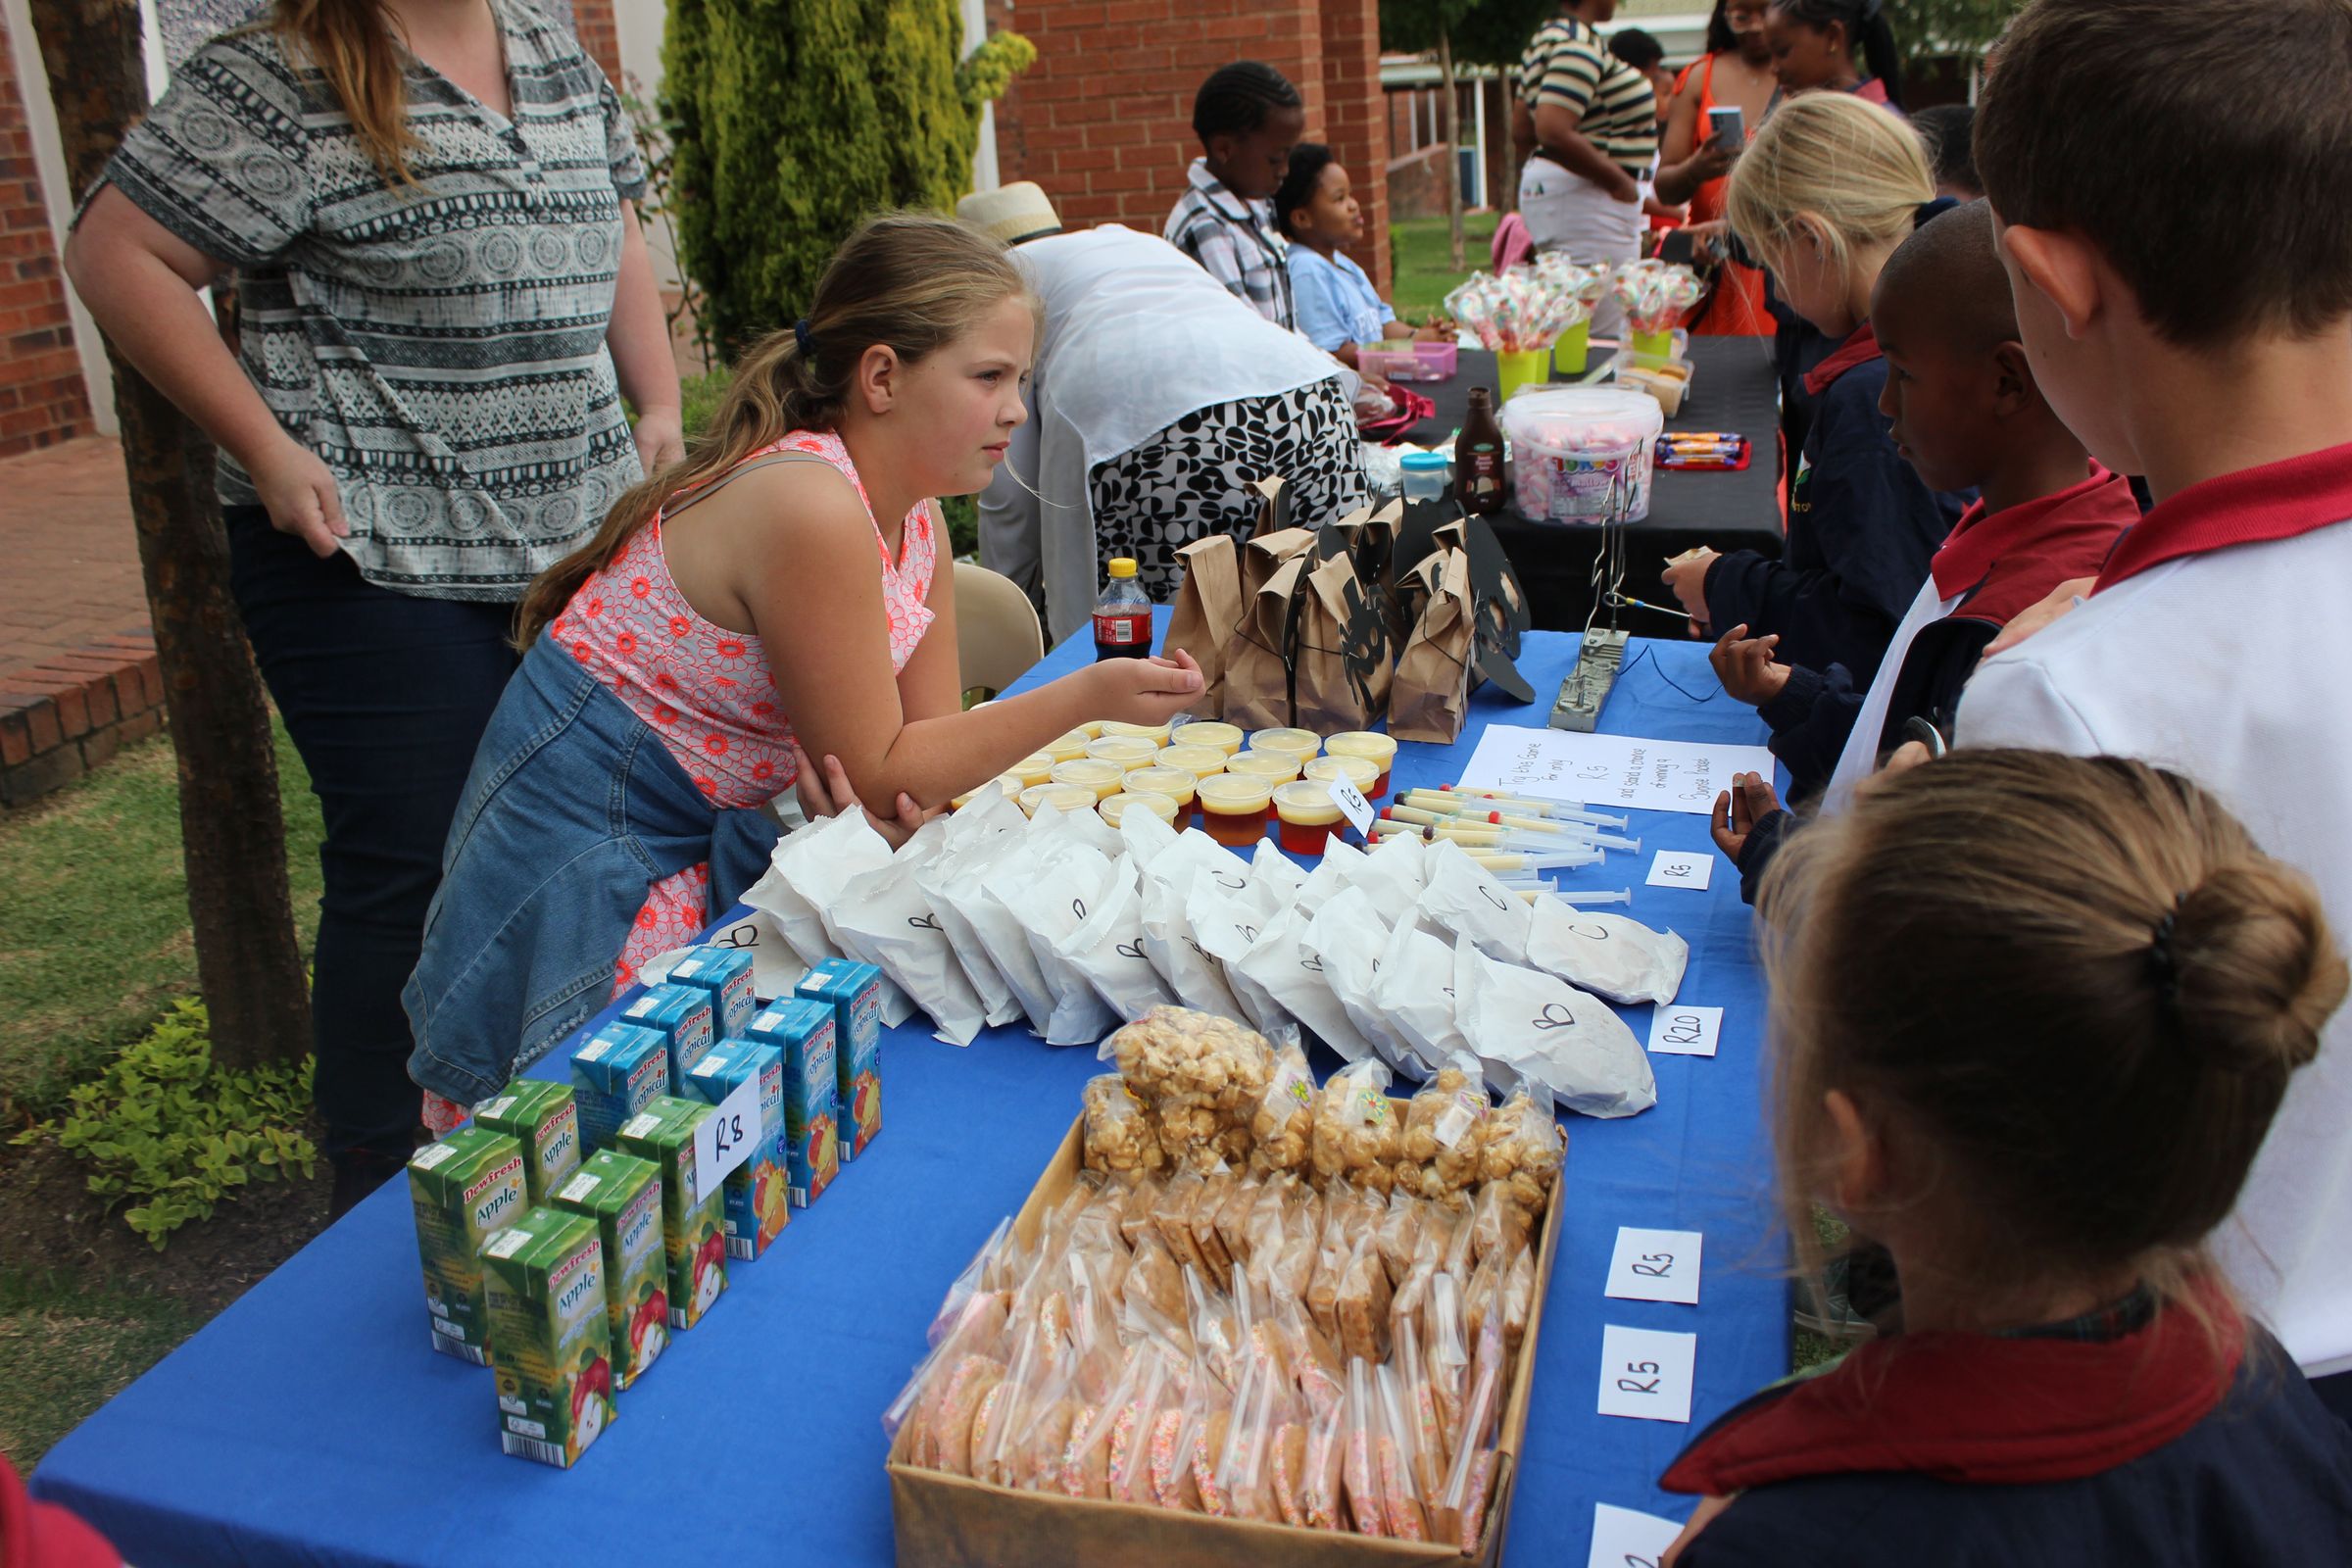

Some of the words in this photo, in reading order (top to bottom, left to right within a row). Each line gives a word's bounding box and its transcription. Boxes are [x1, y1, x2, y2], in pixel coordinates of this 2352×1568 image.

[1498, 775, 1540, 787] Try
[1340, 787, 1363, 814] R5
[1663, 864, 1691, 877] R5
[1662, 1015, 1702, 1045] R20
[760, 1063, 782, 1086] fresh
[543, 1132, 572, 1167] Apple
[715, 1114, 744, 1163] R8
[463, 1155, 522, 1204] Dewfresh
[477, 1188, 517, 1226] Apple
[623, 1212, 653, 1253] Apple
[549, 1238, 601, 1293] Dewfresh
[1632, 1253, 1675, 1278] R5
[559, 1273, 596, 1315] Apple
[1617, 1361, 1661, 1395] R5
